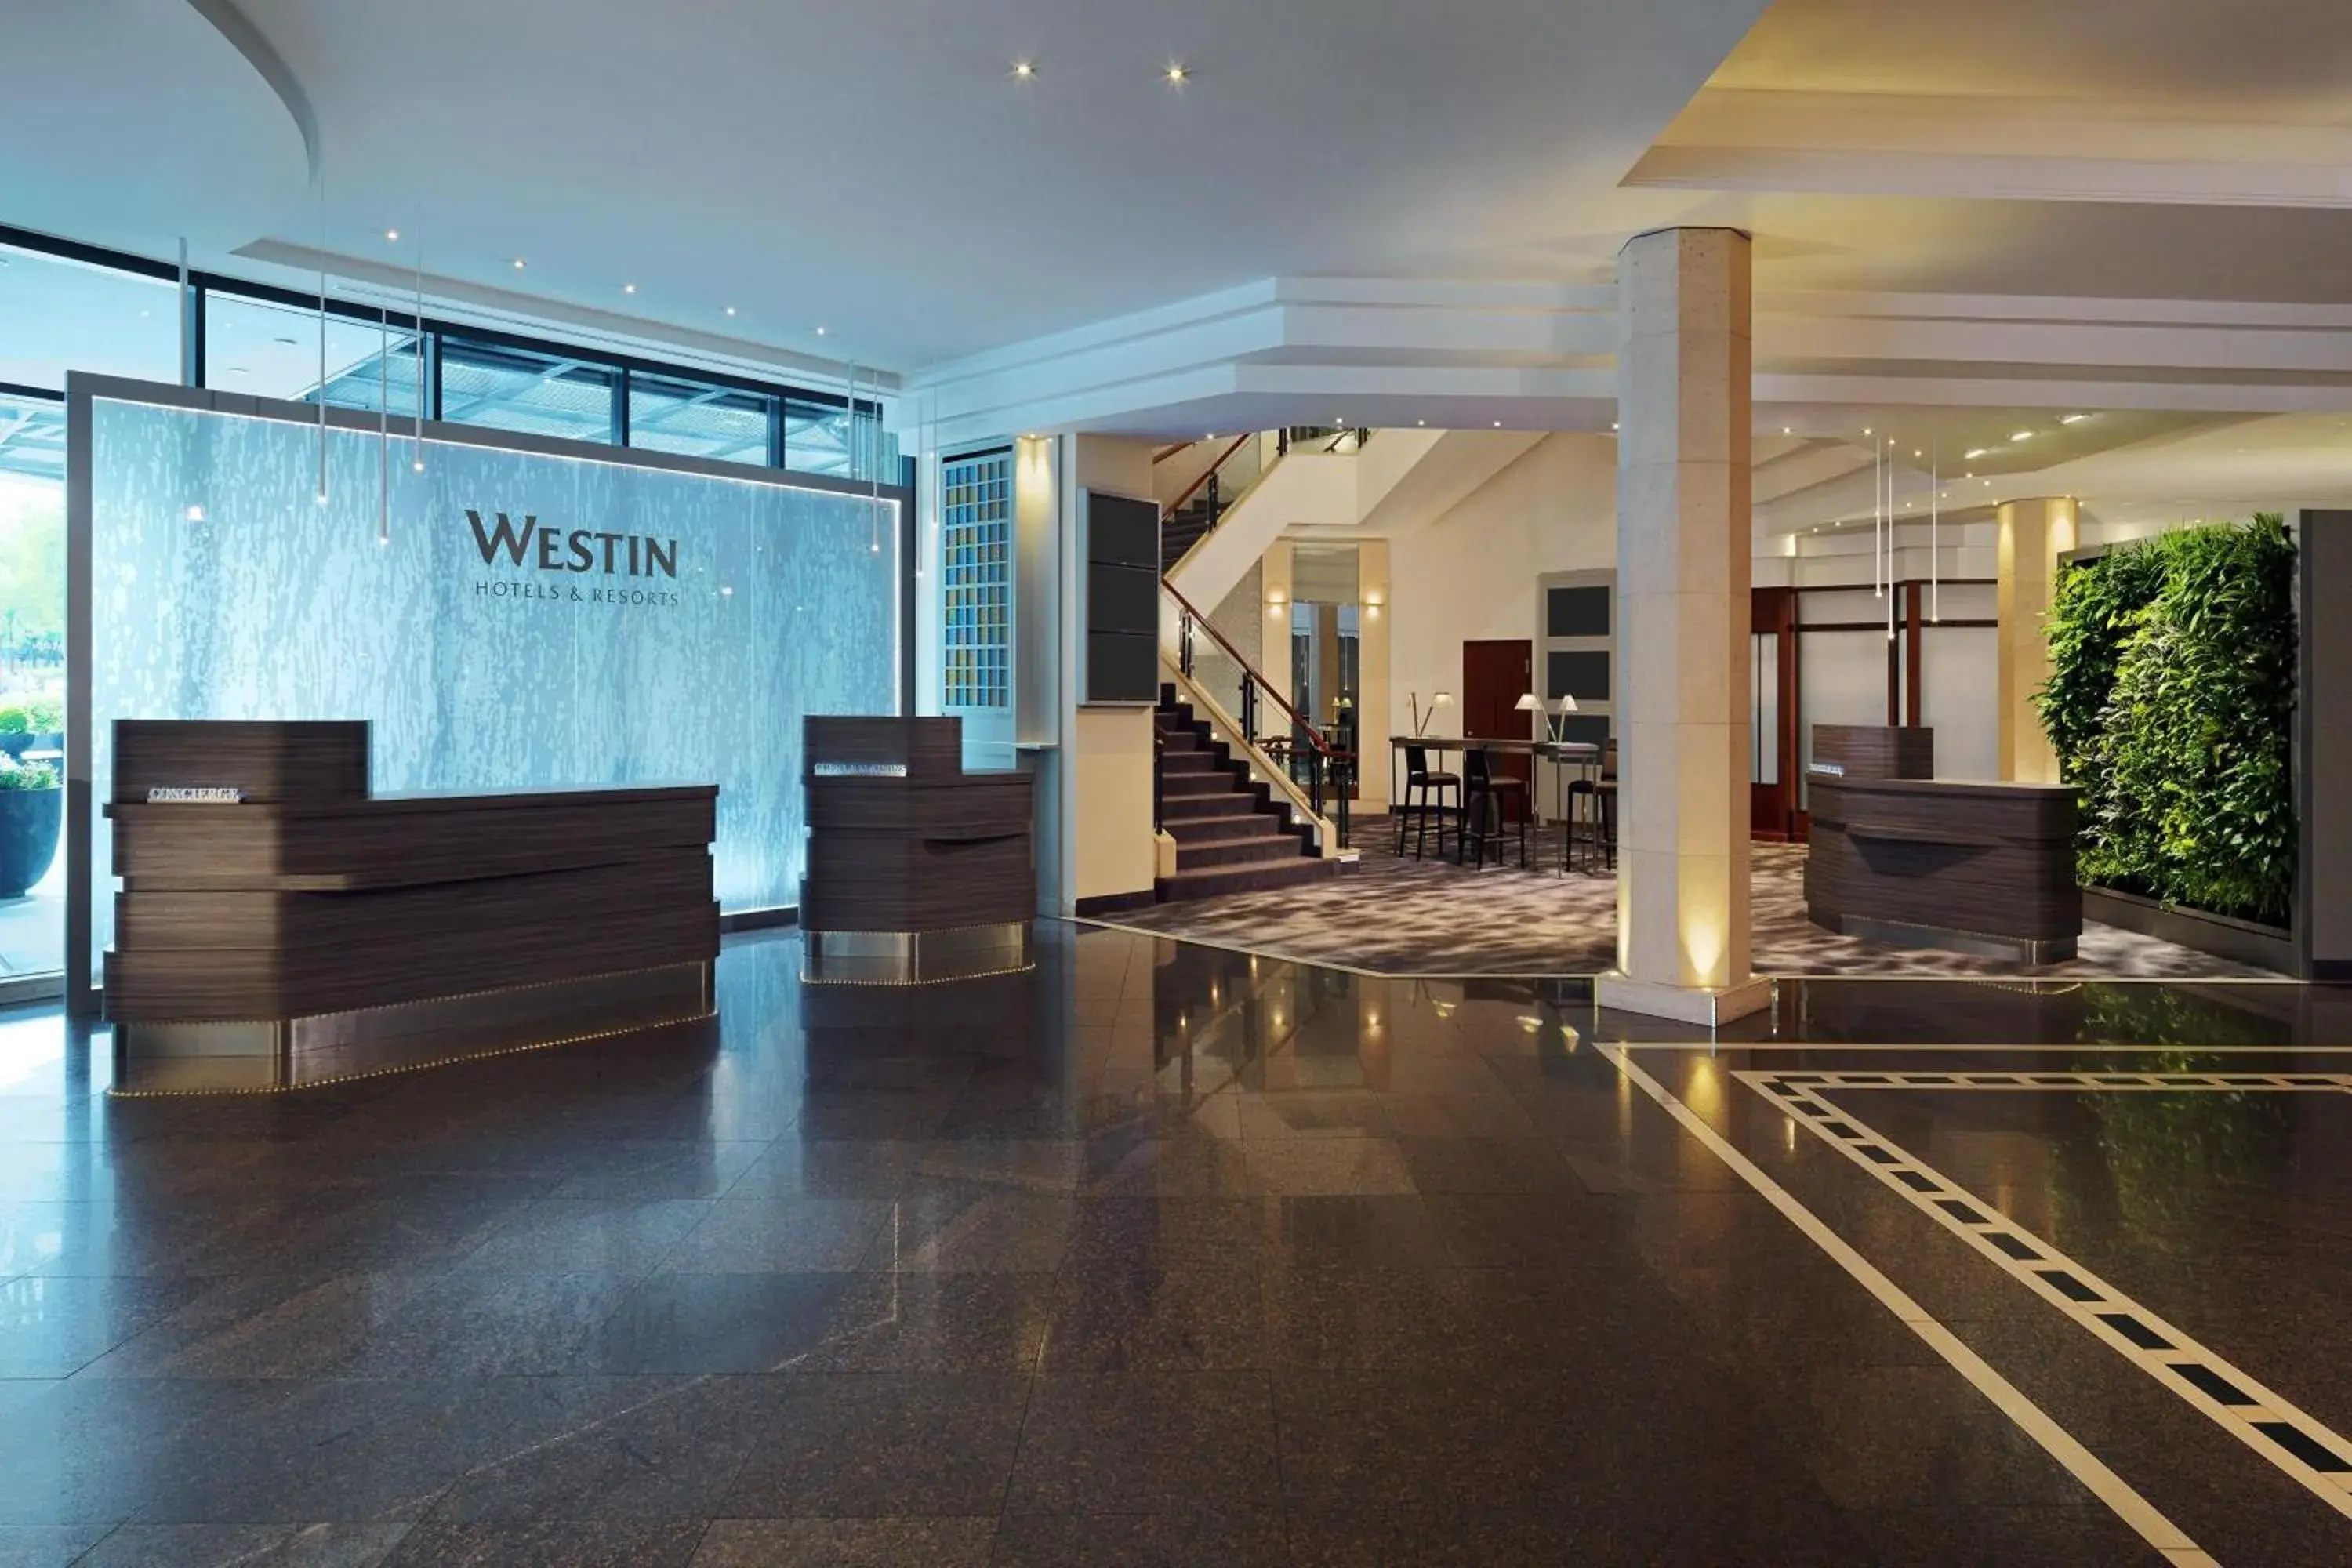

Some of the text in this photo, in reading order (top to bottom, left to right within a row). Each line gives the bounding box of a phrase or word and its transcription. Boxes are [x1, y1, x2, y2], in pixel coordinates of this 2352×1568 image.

[464, 510, 677, 579] WESTIN
[475, 580, 679, 606] HOTELS & RESORTS
